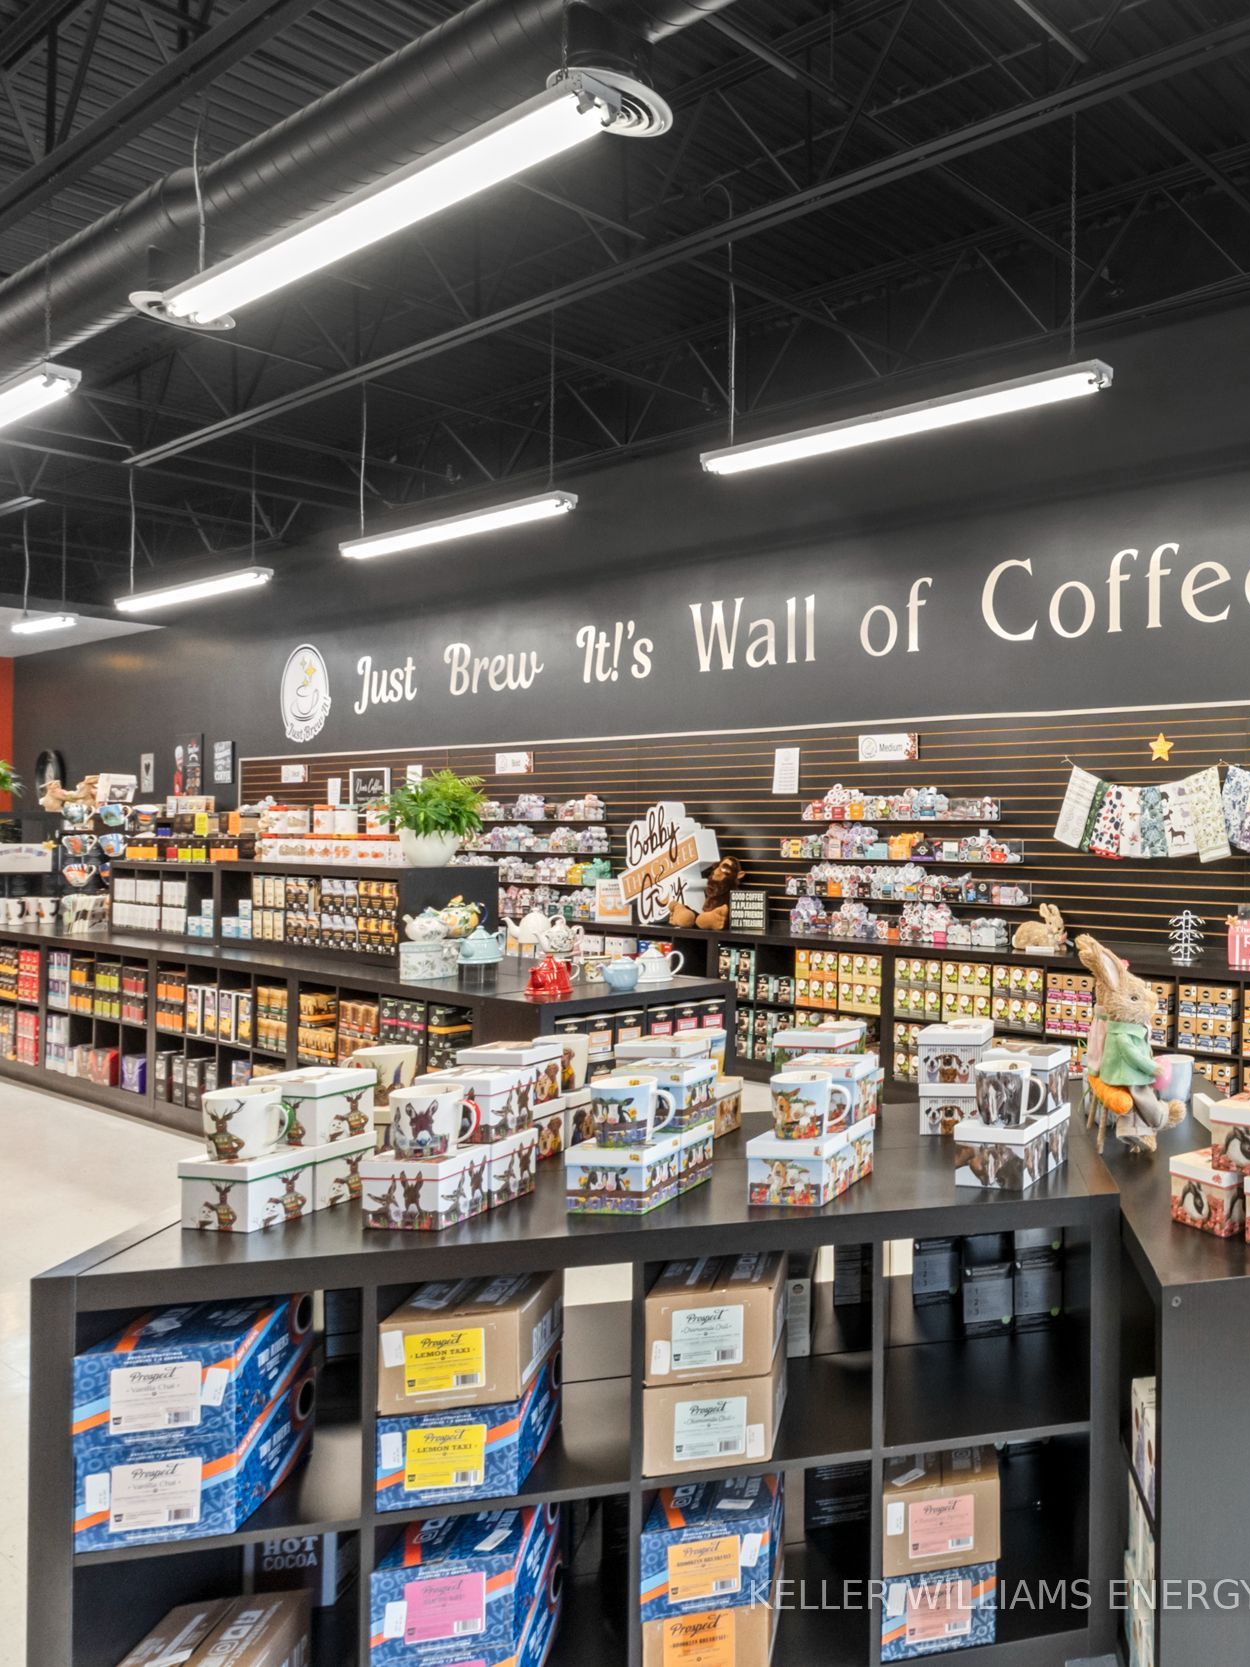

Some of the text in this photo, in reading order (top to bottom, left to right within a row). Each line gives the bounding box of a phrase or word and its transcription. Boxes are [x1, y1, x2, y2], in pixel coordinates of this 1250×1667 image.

[353, 655, 417, 715] Just
[443, 642, 544, 696] Brew
[575, 620, 654, 684] It!'s
[688, 593, 816, 672] Wall
[859, 576, 933, 658] of
[288, 722, 304, 740] Just
[878, 741, 904, 753] Medium
[629, 805, 680, 867] Bobby
[731, 892, 764, 902] GOOD COFFEE
[686, 1308, 728, 1324] Prospect
[421, 1332, 467, 1349] Prospect
[415, 1347, 471, 1359] LEMON TAXI
[129, 1366, 184, 1384] Prospect
[689, 1400, 731, 1417] Prospect
[423, 1428, 469, 1444] Prospect
[416, 1443, 472, 1454] LEMON TAXI
[131, 1462, 184, 1481] Prospect
[263, 1535, 319, 1557] HOT
[263, 1551, 318, 1571] COCOA
[670, 1613, 728, 1638] Prospect
